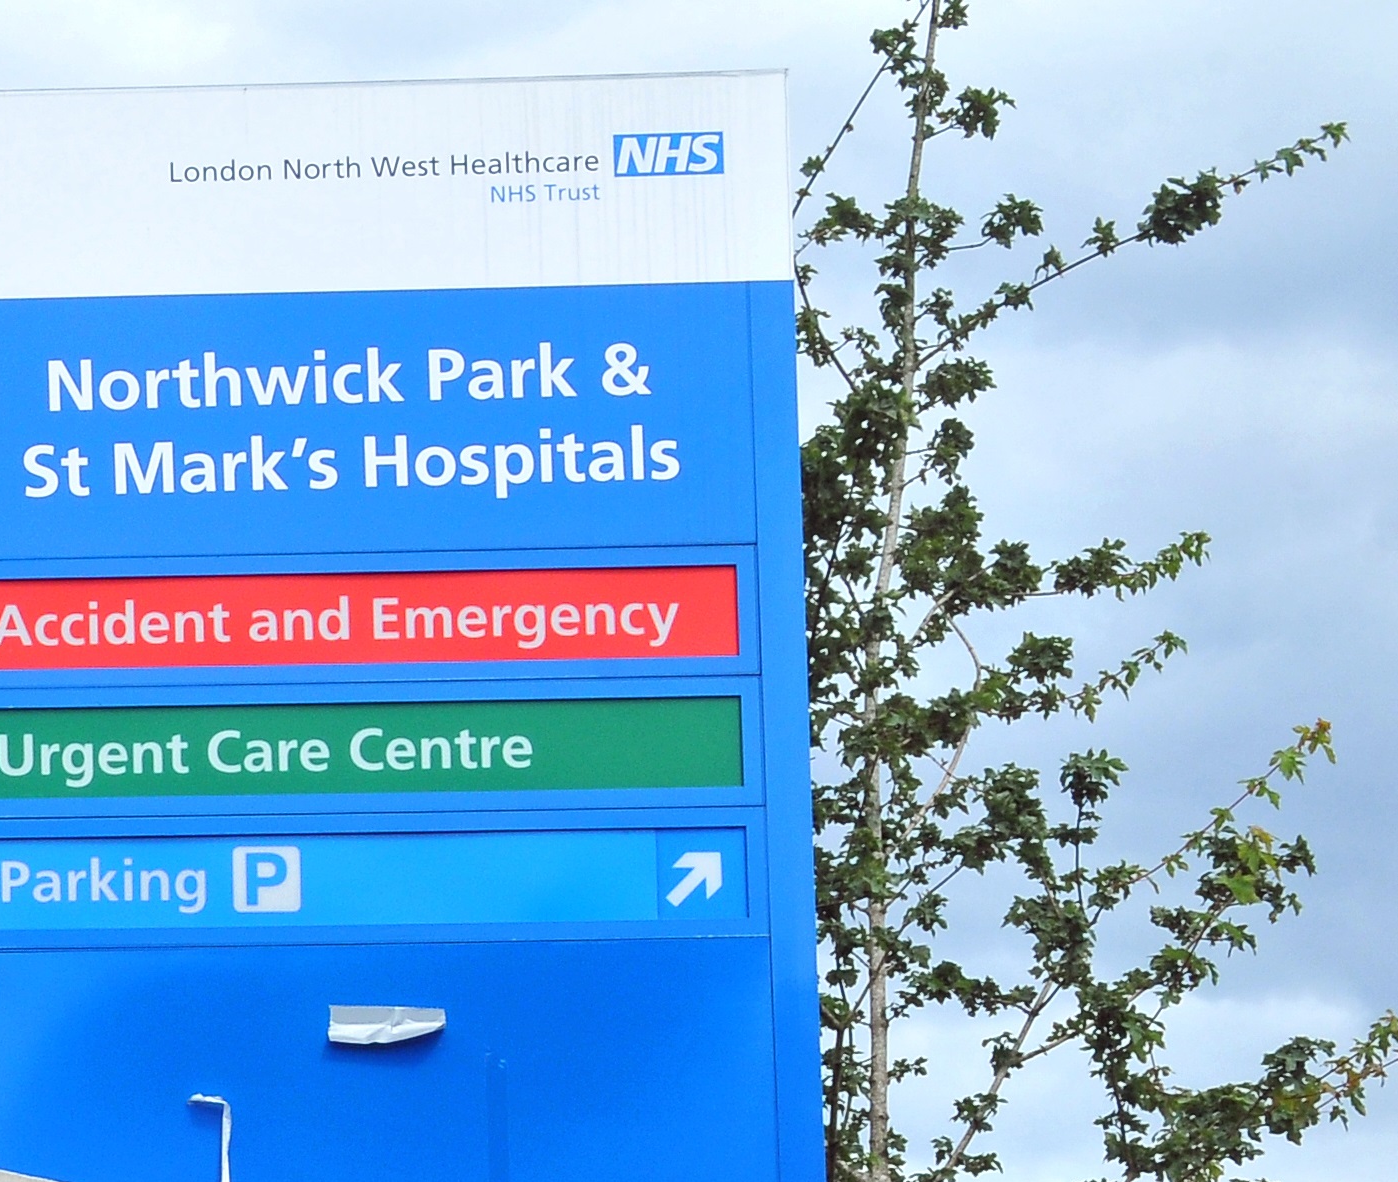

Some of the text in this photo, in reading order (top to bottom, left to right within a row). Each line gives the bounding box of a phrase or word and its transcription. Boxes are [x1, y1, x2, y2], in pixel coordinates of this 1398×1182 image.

[169, 151, 599, 182] London North West Healthcare
[617, 135, 719, 174] NHS
[491, 184, 600, 202] NHS Trust
[47, 342, 651, 411] Northwick Park &
[23, 425, 681, 498] St Mark's Hospitals
[248, 596, 351, 643] and
[372, 597, 680, 649] Emergency
[207, 730, 330, 774] Care
[350, 727, 533, 772] Centre
[0, 854, 288, 914] Parking P
